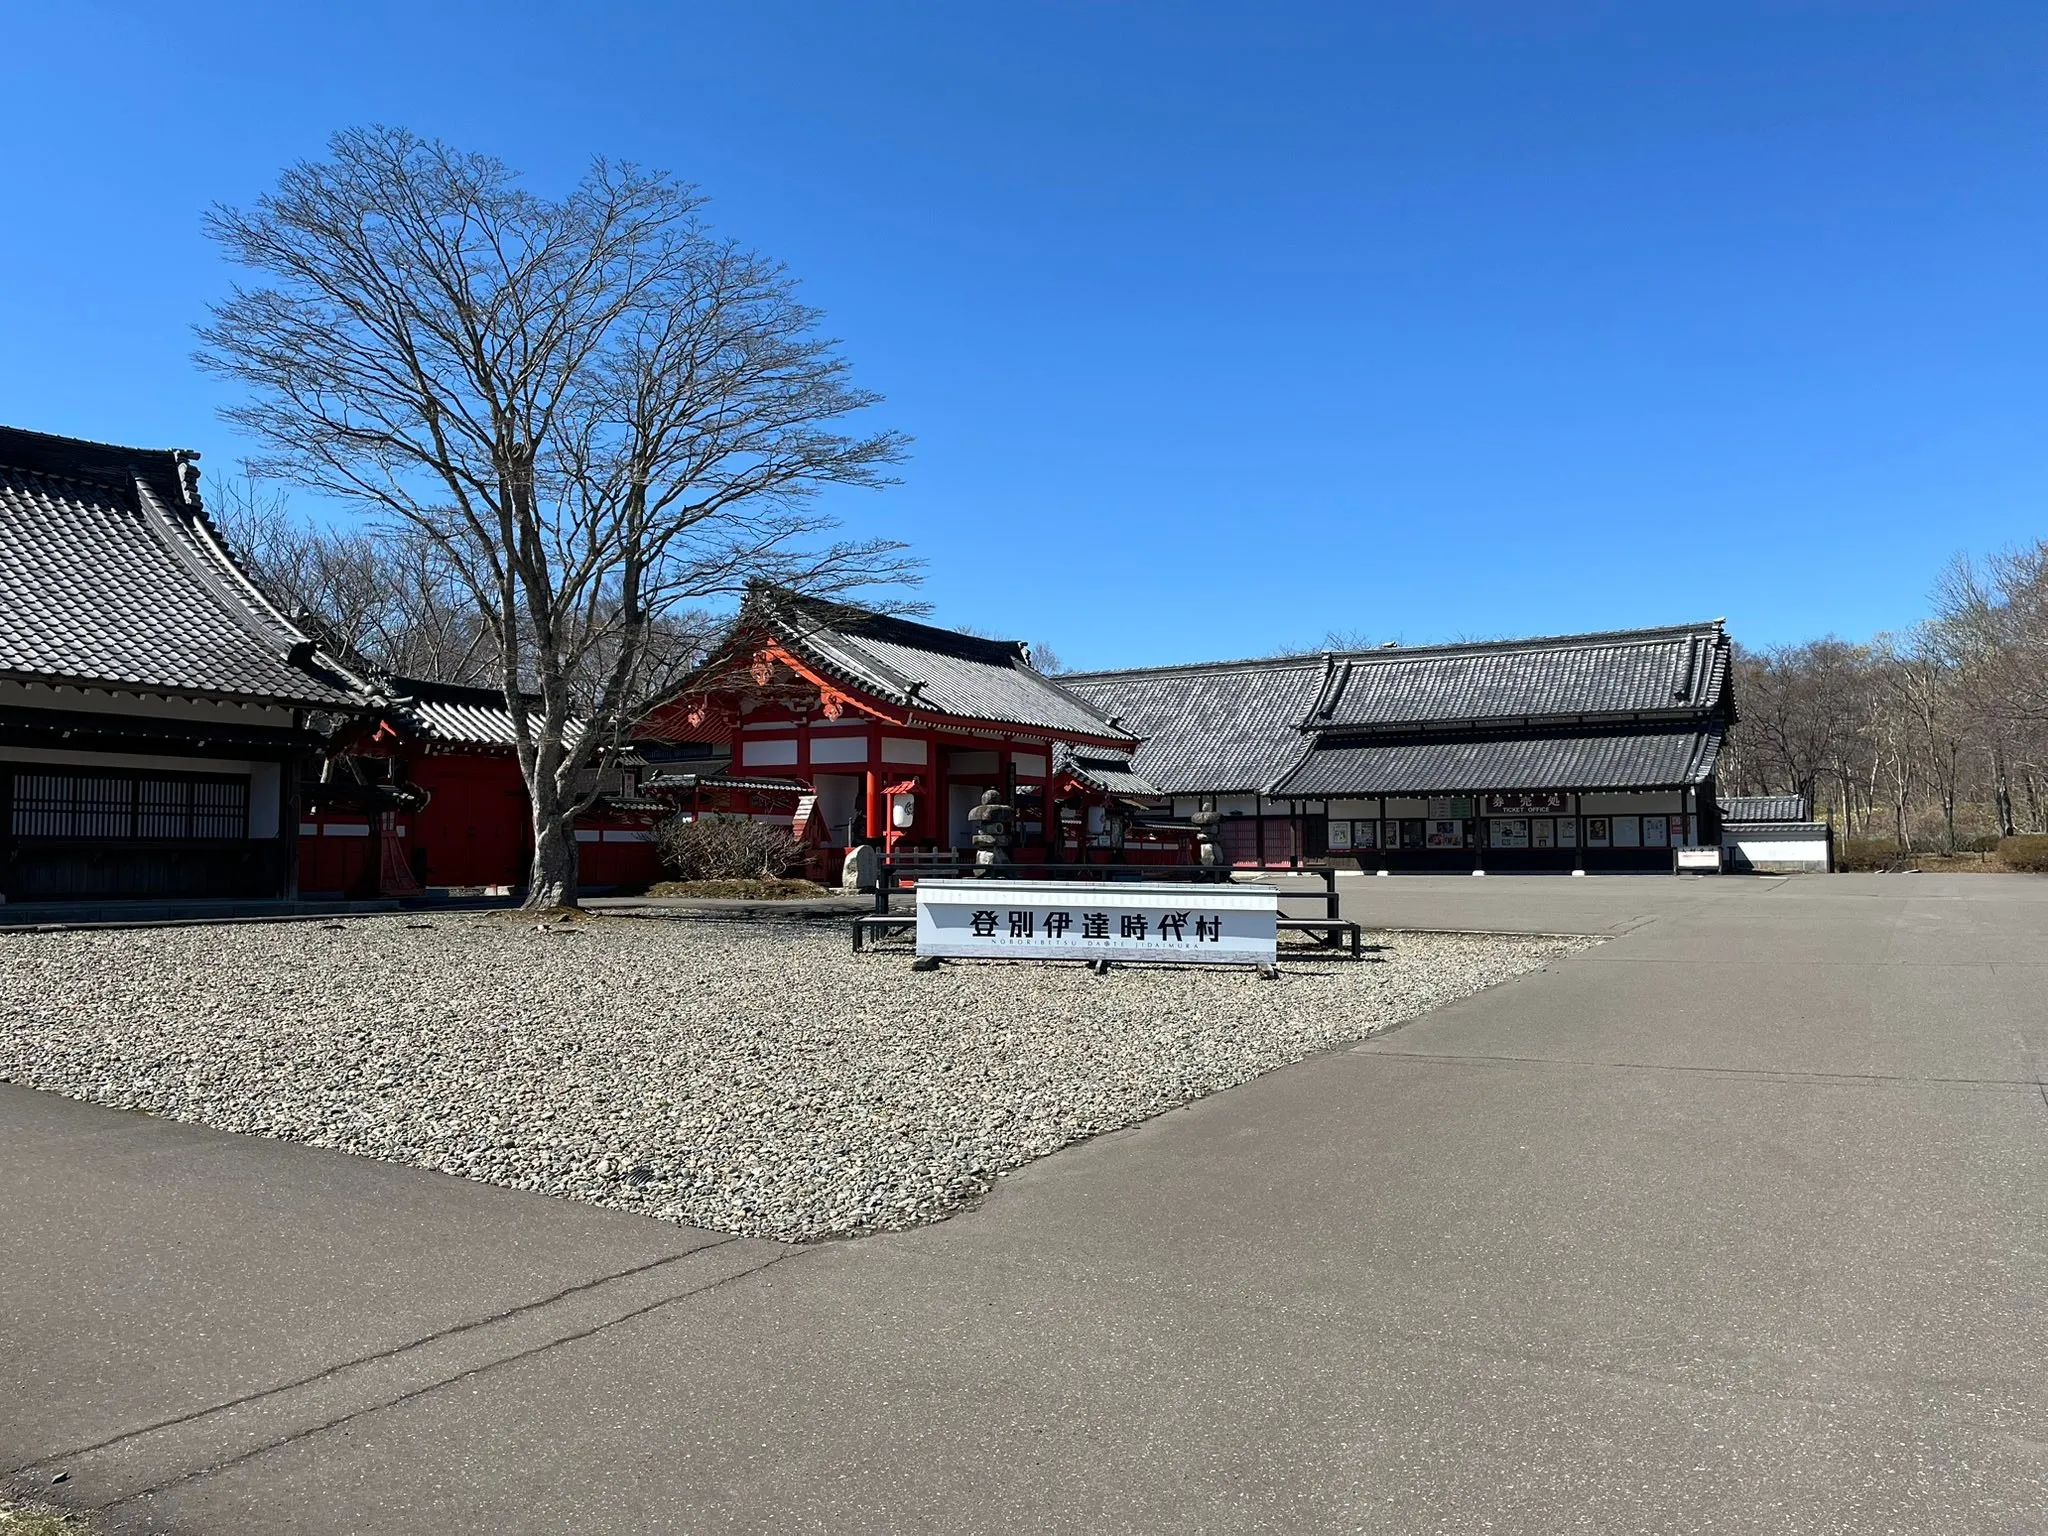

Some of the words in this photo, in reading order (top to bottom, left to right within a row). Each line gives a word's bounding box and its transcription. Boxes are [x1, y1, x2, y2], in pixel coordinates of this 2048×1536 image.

[969, 910, 1222, 942] 登別伊達時代村
[991, 938, 1077, 946] NOBORIBETSU
[1135, 941, 1199, 949] JIDAIMURA
